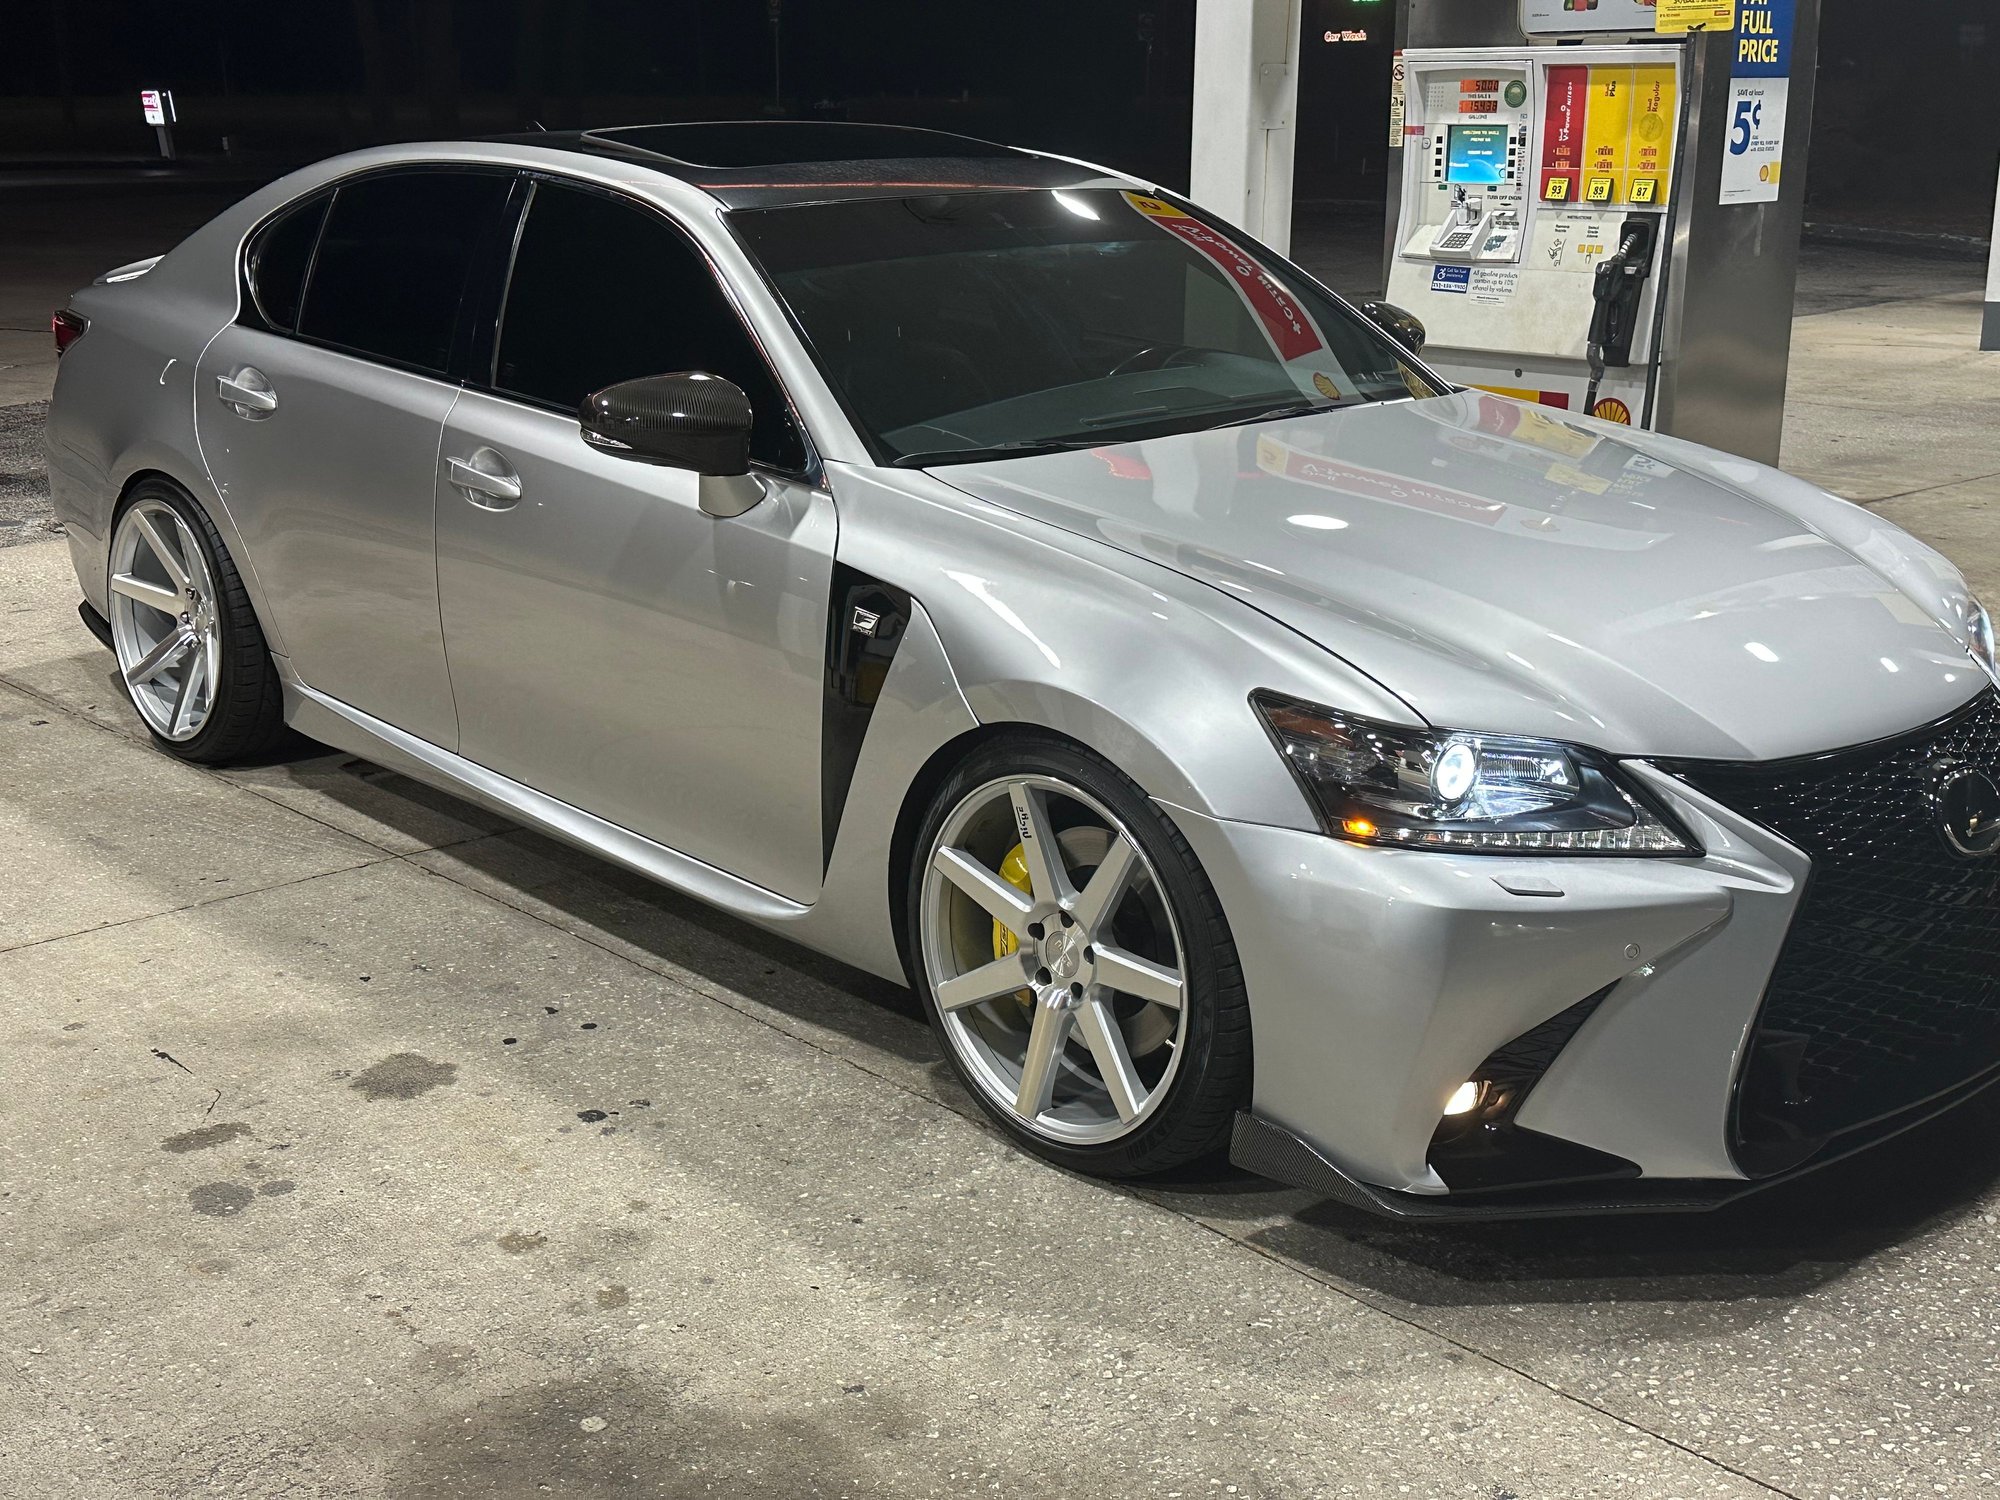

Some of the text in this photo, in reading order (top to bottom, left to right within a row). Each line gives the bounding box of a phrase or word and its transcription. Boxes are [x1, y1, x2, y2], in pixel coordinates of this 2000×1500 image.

[1741, 10, 1773, 34] FULL
[1324, 29, 1367, 42] Car Wash
[1738, 39, 1779, 63] PRICE
[1652, 81, 1660, 112] Regular
[1551, 185, 1562, 195] 93
[1593, 186, 1604, 196] 89
[1636, 187, 1648, 197] 87
